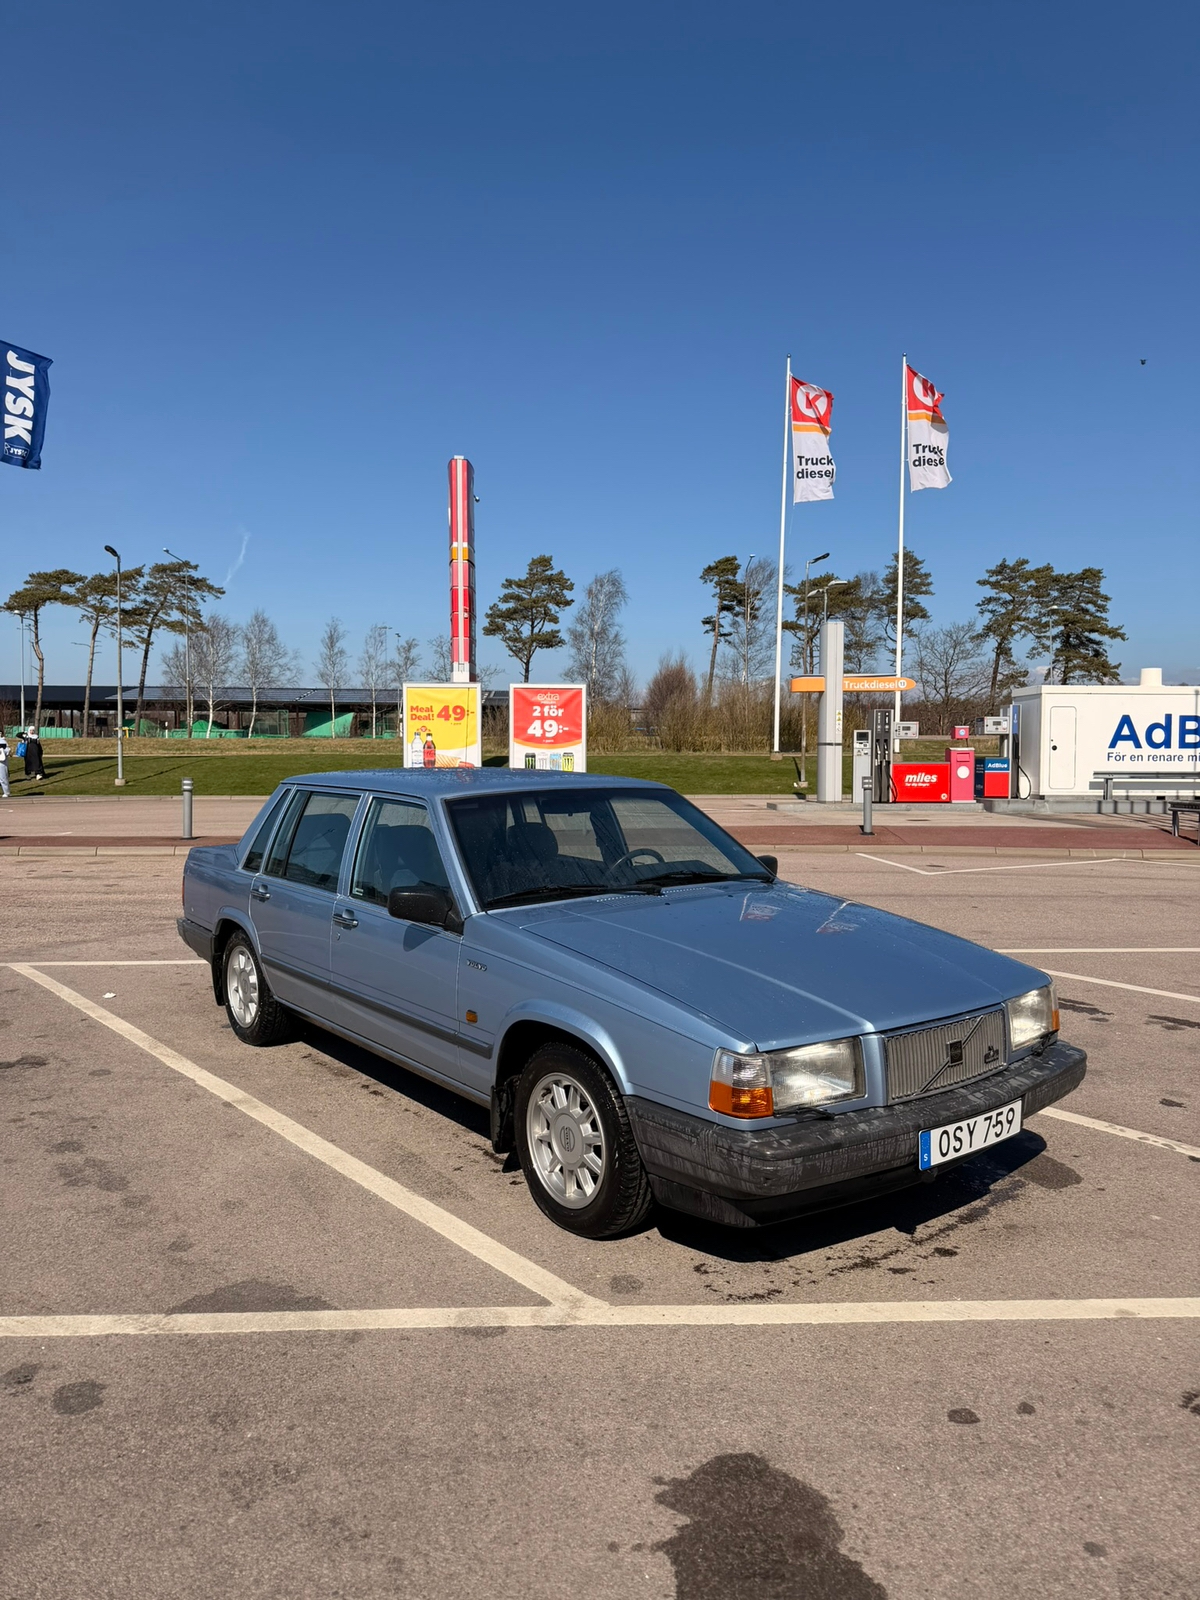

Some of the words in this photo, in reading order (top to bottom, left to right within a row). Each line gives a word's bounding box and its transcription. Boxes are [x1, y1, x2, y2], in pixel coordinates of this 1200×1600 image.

[4, 350, 36, 446] JYSK
[805, 391, 824, 417] K
[797, 455, 834, 466] Truck
[796, 468, 835, 479] diesel
[843, 680, 898, 689] Truckdiesel
[537, 692, 560, 701] extra
[410, 705, 434, 713] Meal
[436, 705, 475, 721] 49:-
[532, 706, 541, 717] 2
[543, 705, 565, 717] för
[410, 713, 435, 721] Deal!
[527, 720, 569, 738] 49:-
[1107, 751, 1127, 762] För
[1129, 754, 1144, 762] en
[1147, 754, 1184, 762] renare
[904, 772, 938, 783] miles
[939, 1120, 977, 1158] OSY
[984, 1107, 1015, 1144] 759
[923, 1153, 928, 1162] S
